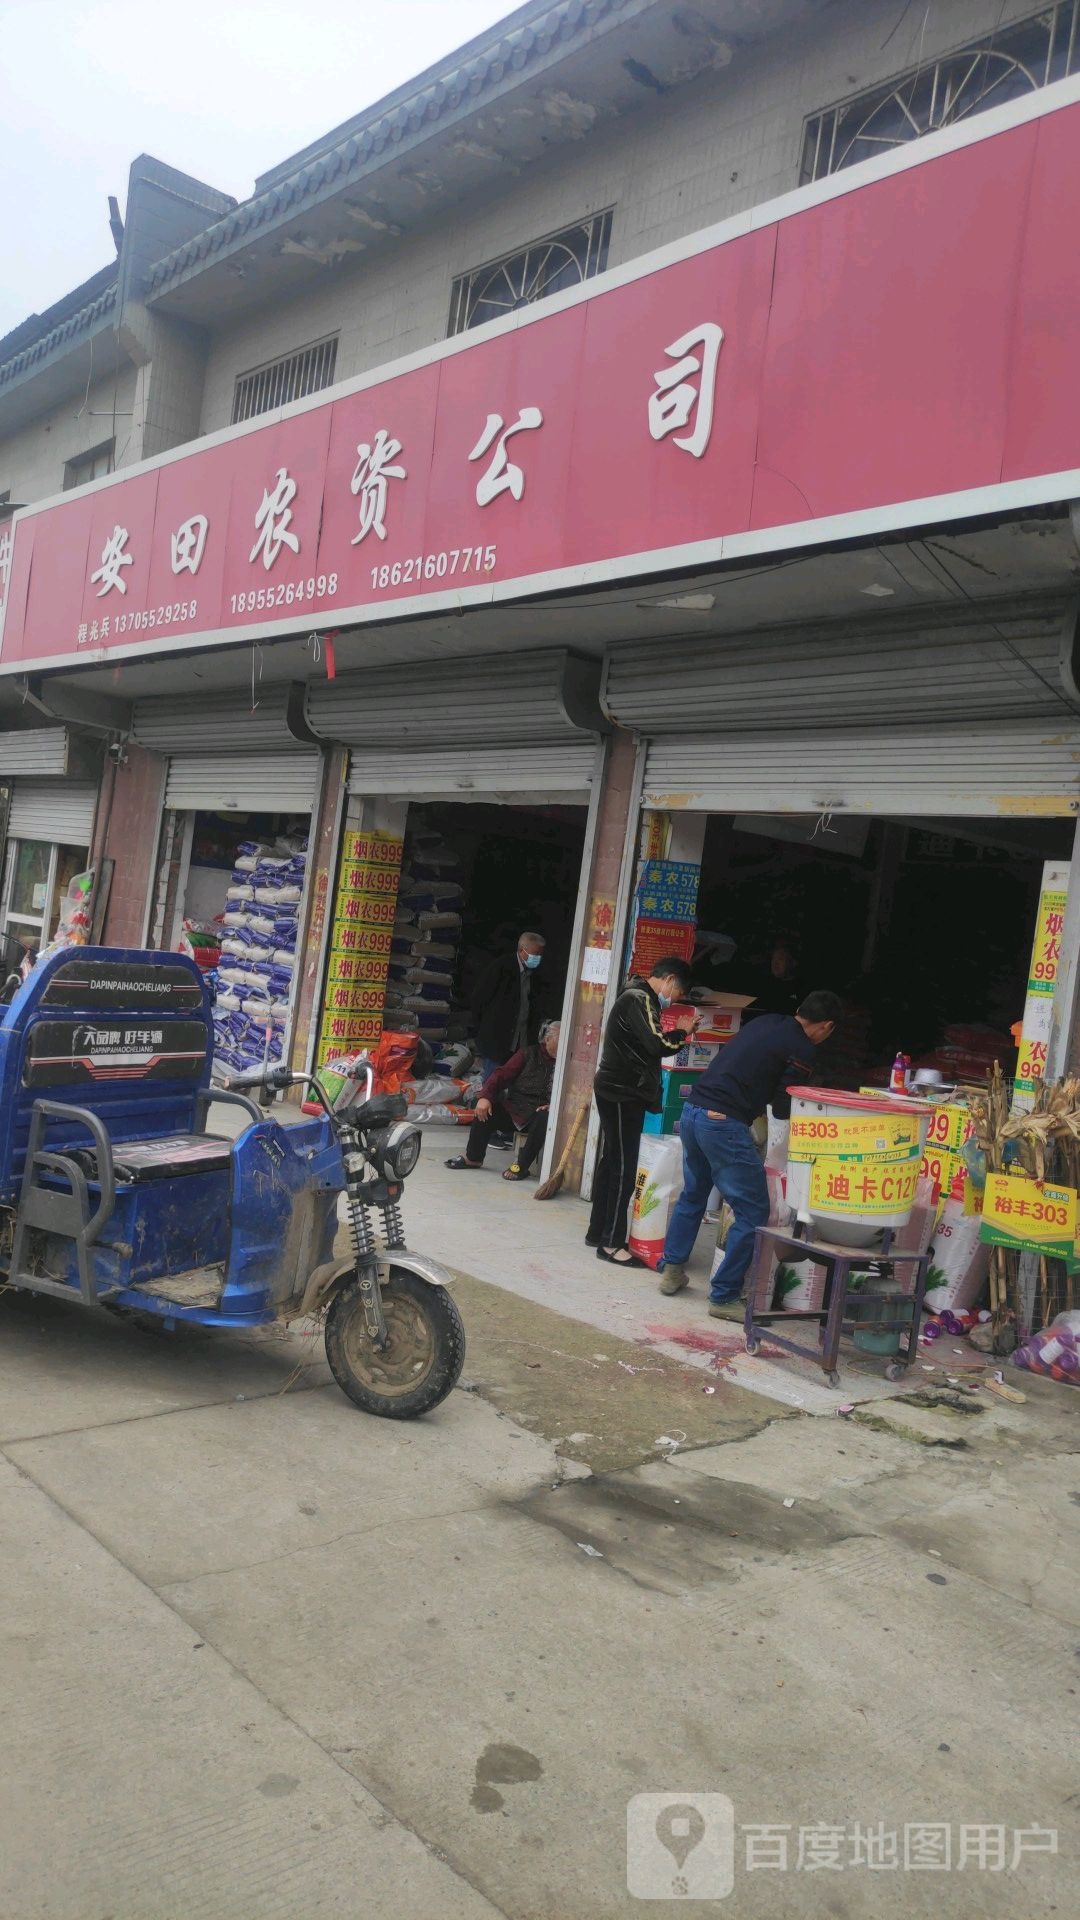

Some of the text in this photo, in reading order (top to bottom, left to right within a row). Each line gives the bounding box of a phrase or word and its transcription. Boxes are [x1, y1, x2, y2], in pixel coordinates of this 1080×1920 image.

[90, 322, 724, 597] 安田农资公司
[115, 600, 198, 633] 13705529258
[230, 573, 338, 616] 18955264998
[370, 545, 497, 590] 18621607715
[353, 840, 403, 862] 烟农999
[350, 869, 400, 891] 烟农999
[345, 899, 396, 922] 烟农999
[341, 928, 392, 951] 烟农999
[338, 959, 389, 980] 烟农999
[90, 979, 172, 993] DAPINPAIHAOCHELIANG
[334, 988, 385, 1009] 烟农999
[84, 1031, 120, 1045] 大品牌
[331, 1018, 382, 1038] 烟农999
[1020, 1062, 1044, 1079] 99
[791, 1122, 838, 1138] 裕丰303
[995, 1195, 1067, 1225] 裕丰303
